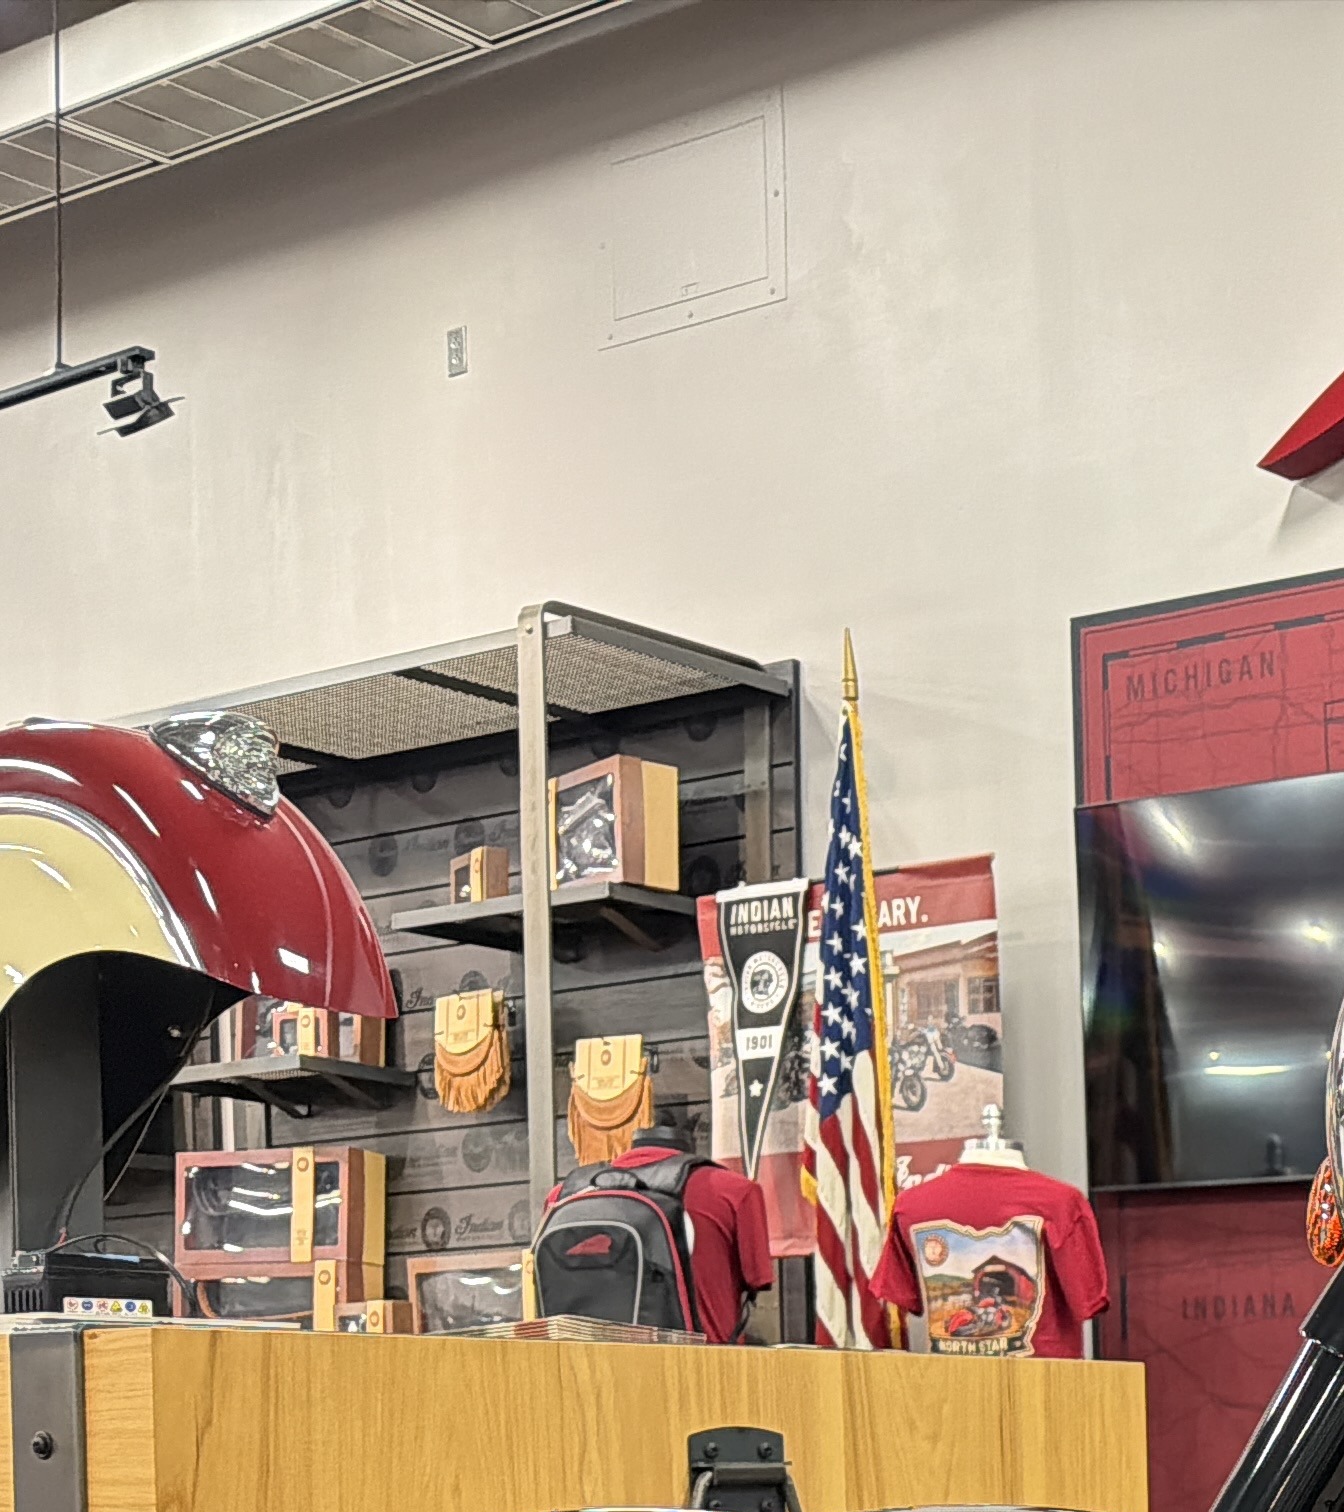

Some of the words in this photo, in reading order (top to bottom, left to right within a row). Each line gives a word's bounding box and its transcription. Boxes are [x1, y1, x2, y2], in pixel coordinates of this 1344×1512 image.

[1125, 648, 1277, 702] MICHIGAN
[729, 896, 795, 926] INDIAN
[745, 1034, 773, 1050] 1901
[1181, 1291, 1296, 1322] INDIANA
